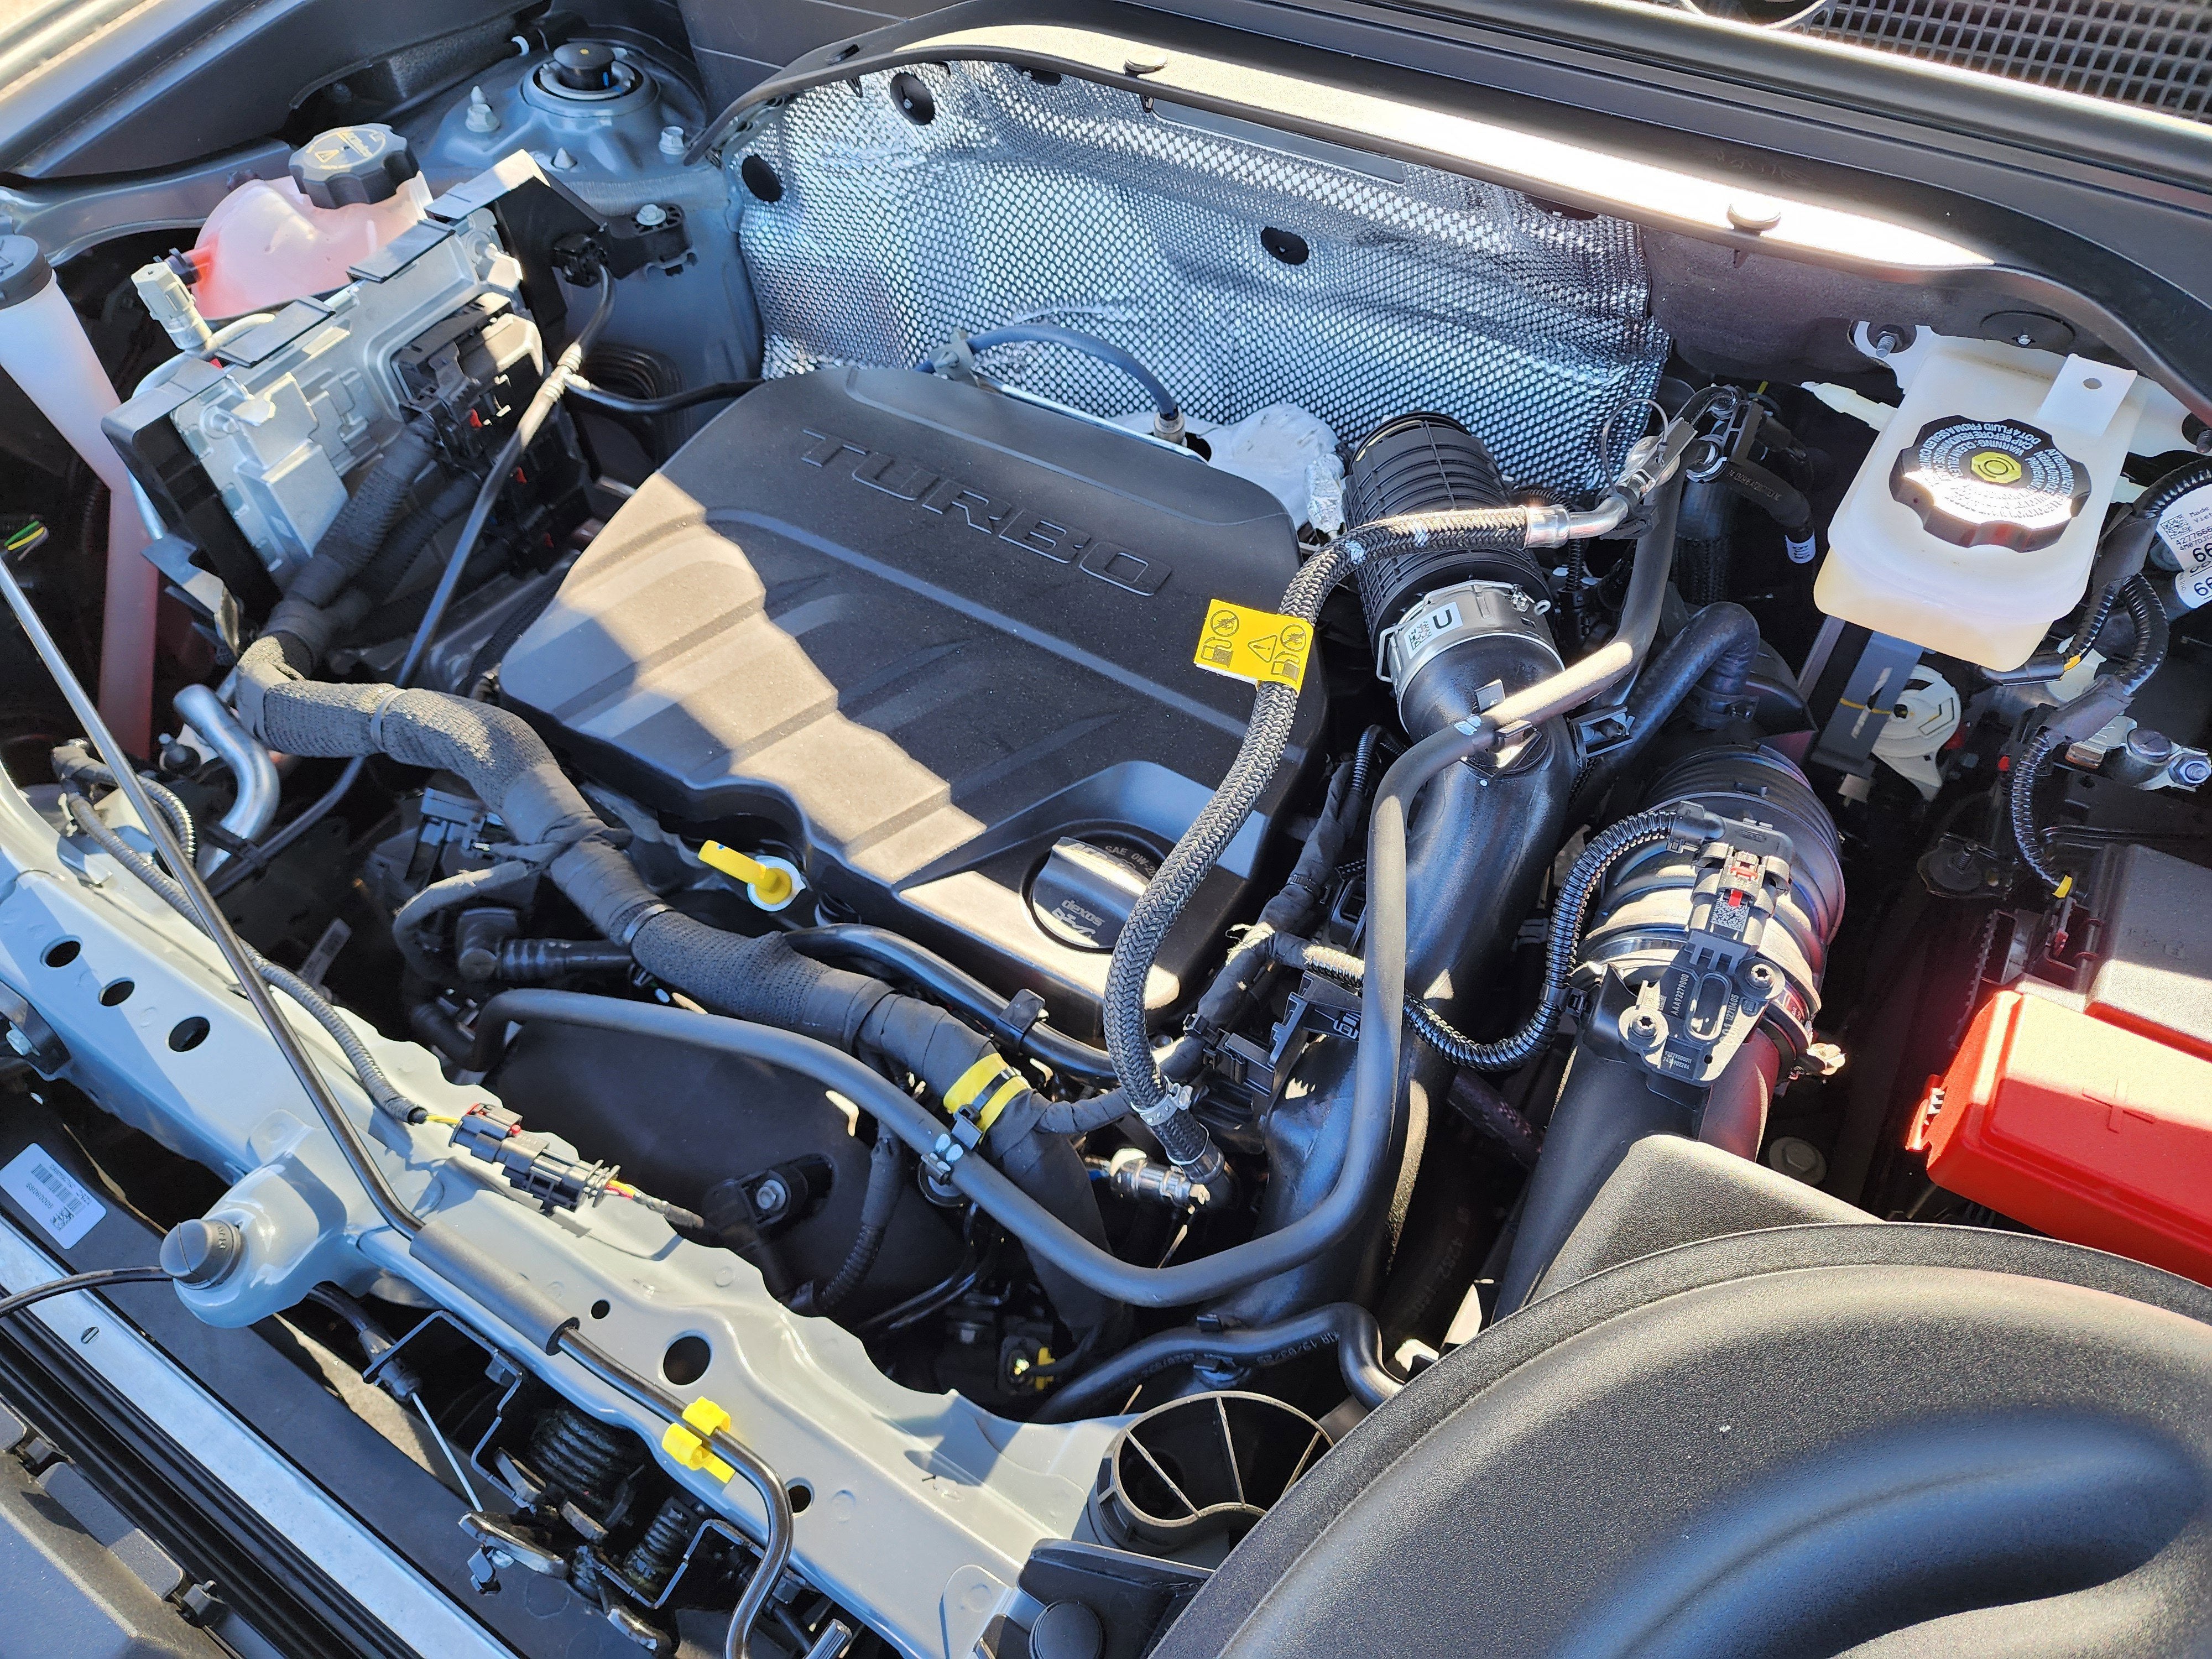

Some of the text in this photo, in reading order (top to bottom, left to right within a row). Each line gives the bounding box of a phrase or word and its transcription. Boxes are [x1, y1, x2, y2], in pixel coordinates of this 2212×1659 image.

[1951, 422, 1983, 433] FROM
[1982, 422, 2013, 435] FLUID
[2012, 427, 2022, 437] 4
[1922, 427, 1951, 451] SEALED
[1970, 431, 2012, 442] BEFORE
[2010, 436, 2034, 450] CAP
[2018, 430, 2042, 445] DOT
[1949, 440, 1978, 458] CLEAN
[1947, 456, 1964, 478] FILLER
[802, 429, 1172, 597] TURBO
[2189, 506, 2210, 518] Made
[1432, 608, 1453, 629] U
[1105, 845, 1129, 855] SAE
[1061, 899, 1105, 927] dexos
[1670, 973, 1689, 1016] AAA93279000
[1725, 993, 1739, 1022] 12711405
